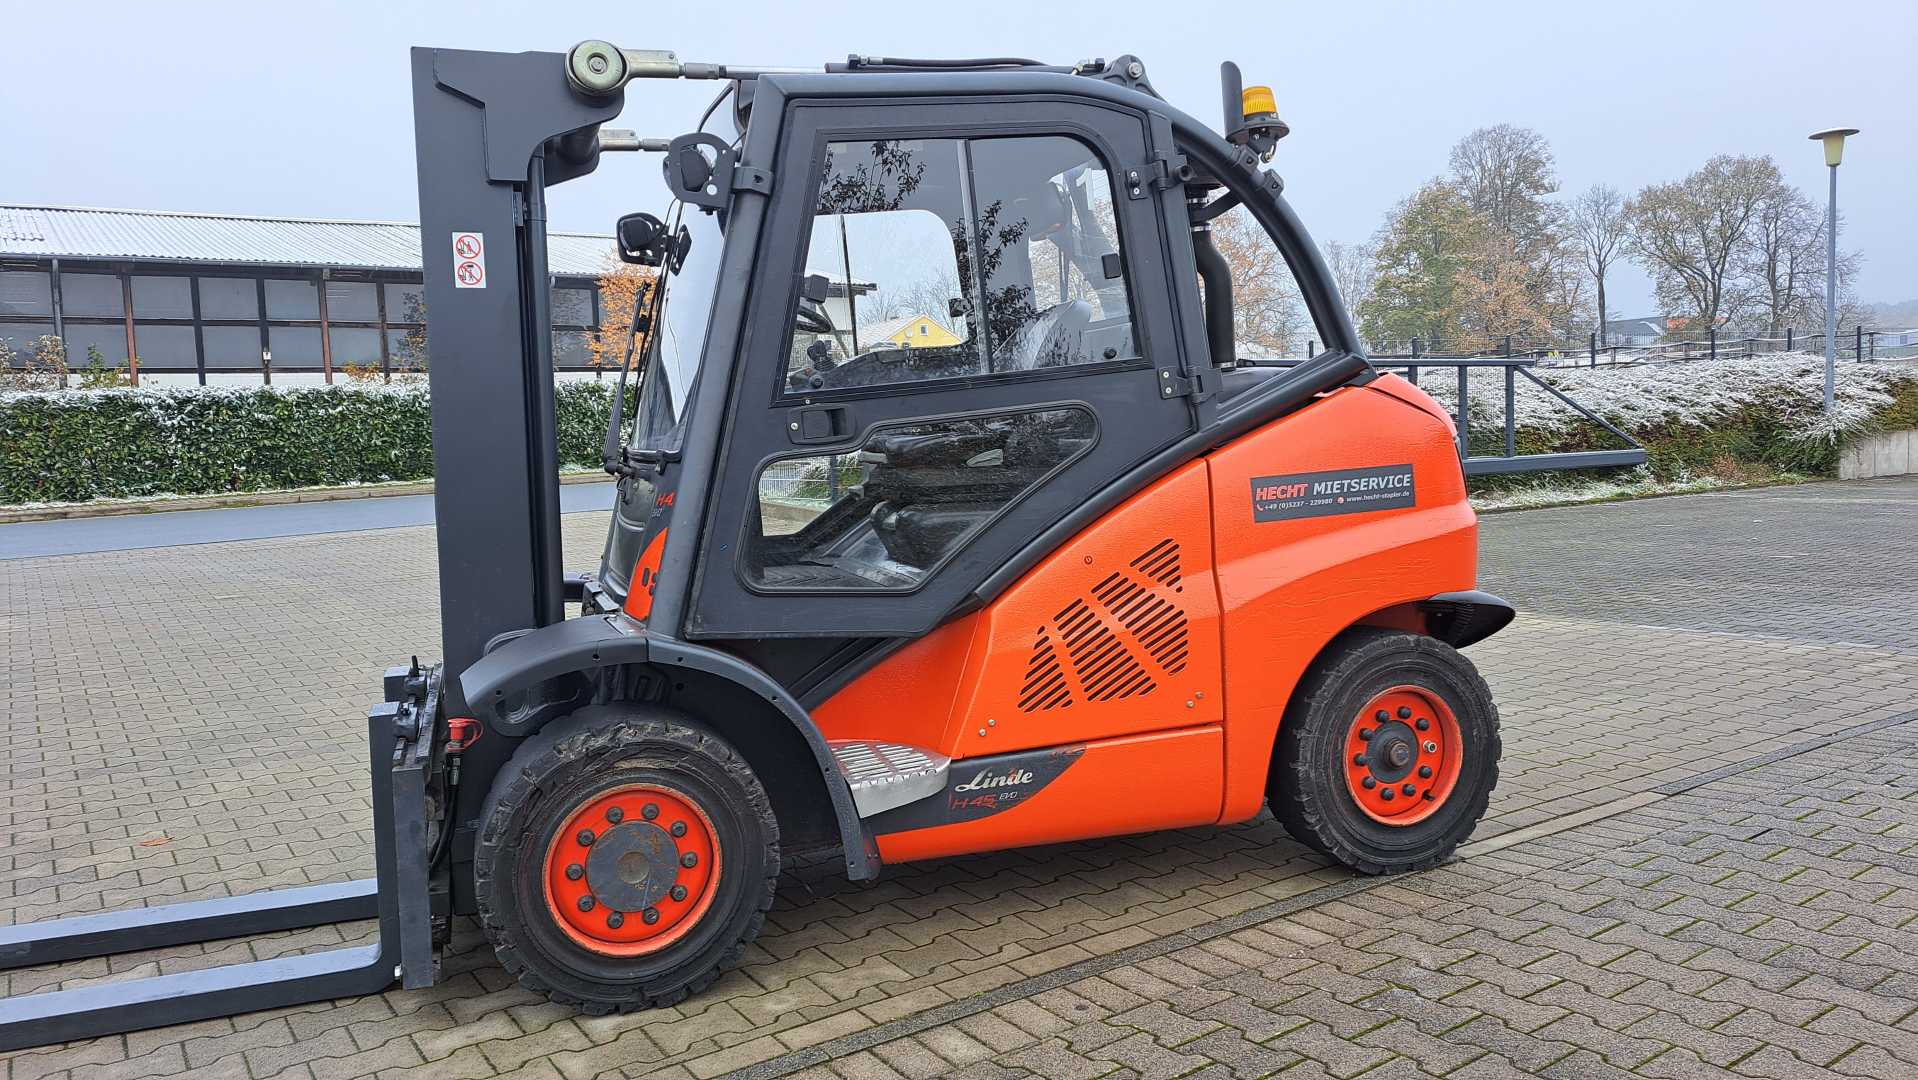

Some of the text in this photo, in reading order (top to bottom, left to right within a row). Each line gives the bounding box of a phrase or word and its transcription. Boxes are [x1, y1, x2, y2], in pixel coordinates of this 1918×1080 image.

[1256, 474, 1412, 501] HECHT MIETSERVICE
[954, 767, 1033, 792] Linde
[999, 791, 1018, 800] EVO
